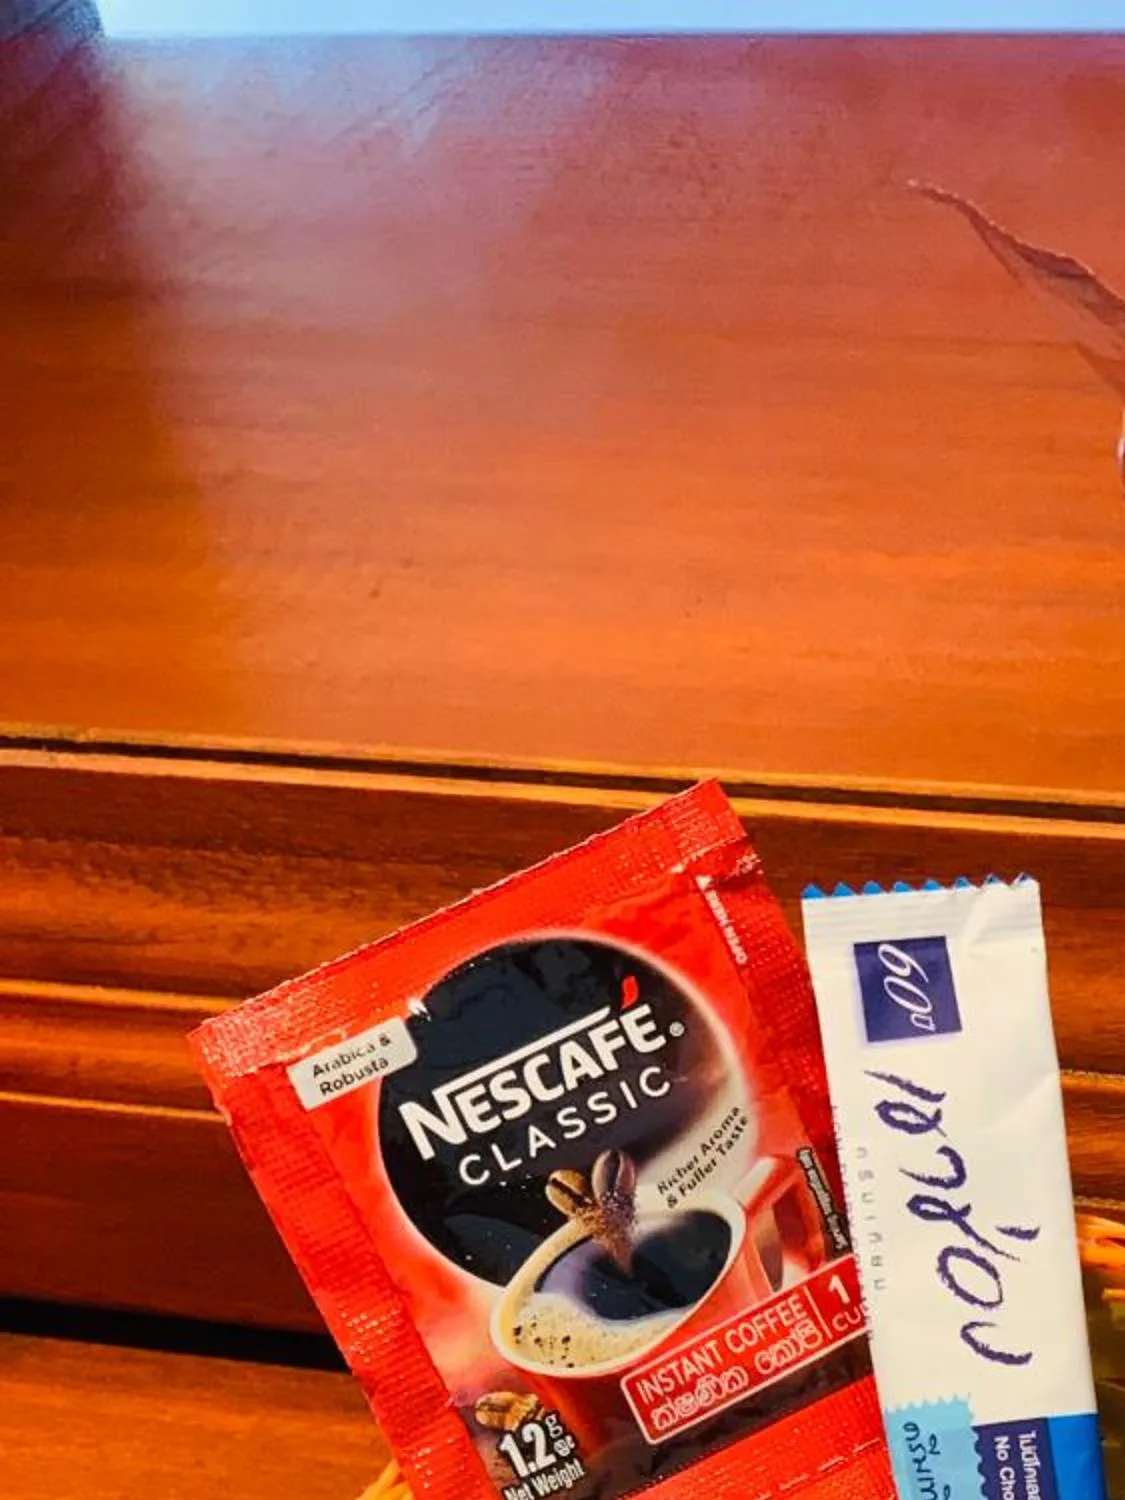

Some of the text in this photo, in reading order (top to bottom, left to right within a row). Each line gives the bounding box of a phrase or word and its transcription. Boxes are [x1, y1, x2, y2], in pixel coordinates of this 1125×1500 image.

[312, 1031, 392, 1079] Arabica &
[318, 1057, 390, 1096] Robusta
[399, 976, 667, 1161] NESCAFÉ
[459, 1066, 671, 1186] CLASSIC
[657, 1106, 740, 1195] Richer Aroma
[667, 1116, 748, 1209] & Fuller Taste
[828, 1274, 851, 1304] 1
[636, 1294, 808, 1405] INSTANT COFFEE
[530, 1458, 585, 1497] Weight
[994, 1435, 1011, 1462] No
